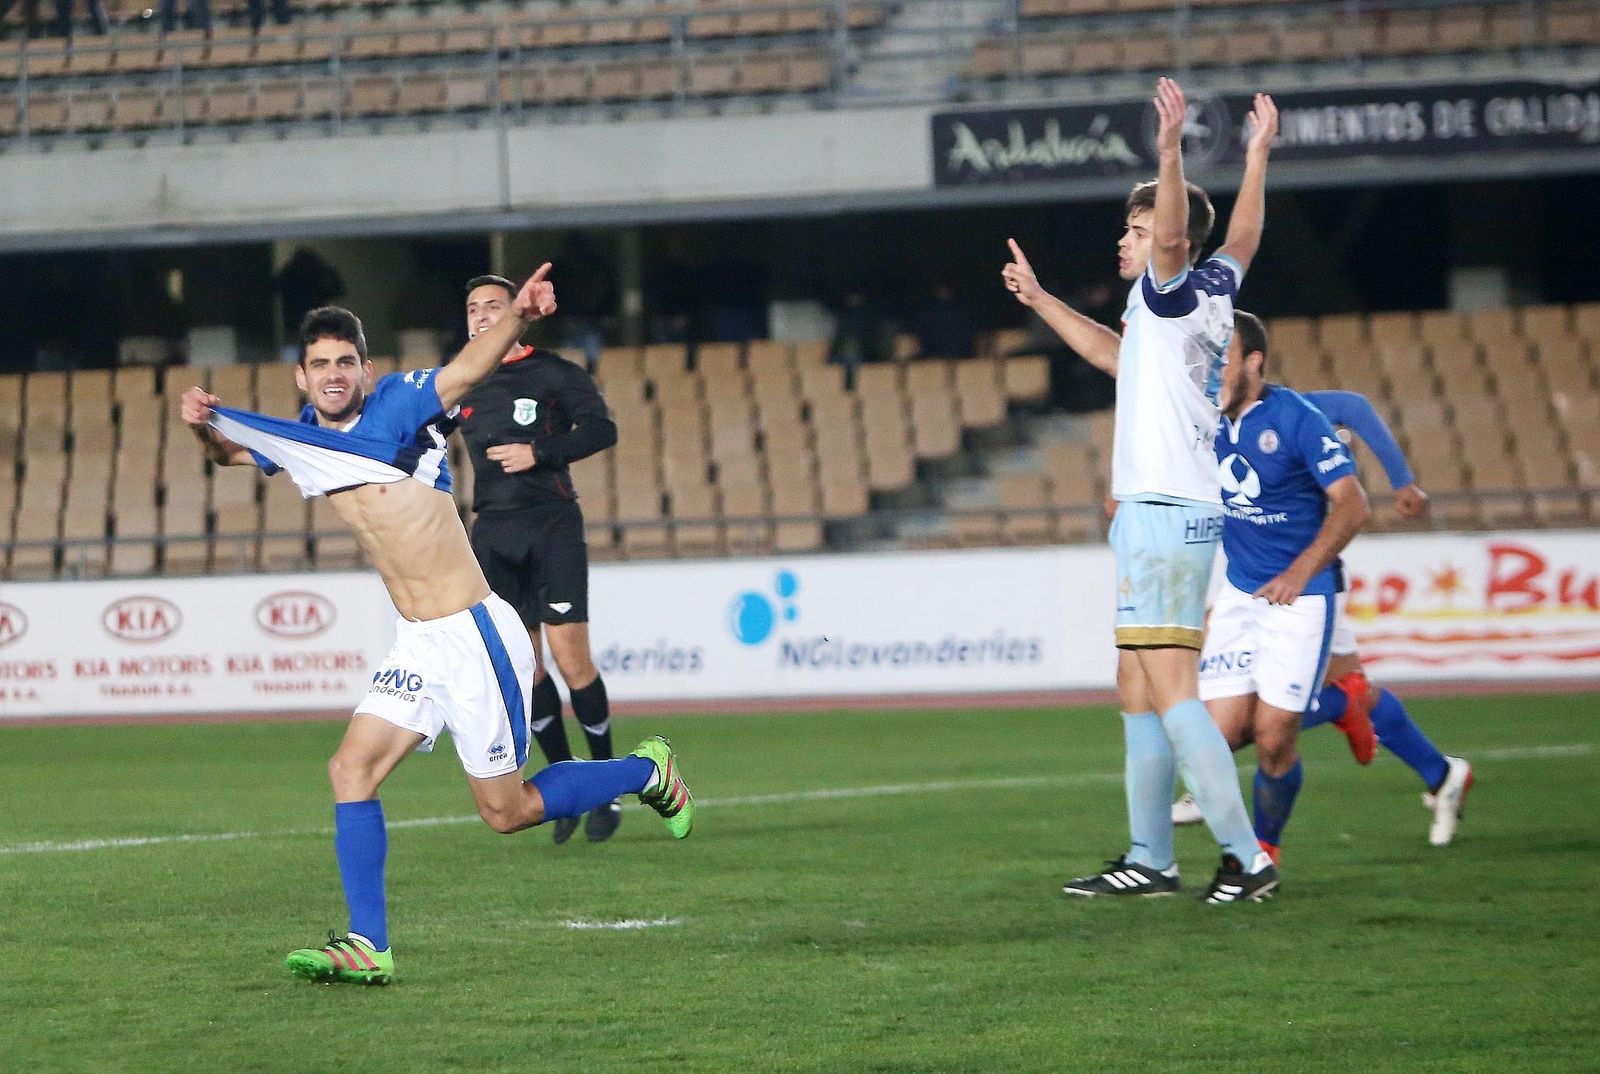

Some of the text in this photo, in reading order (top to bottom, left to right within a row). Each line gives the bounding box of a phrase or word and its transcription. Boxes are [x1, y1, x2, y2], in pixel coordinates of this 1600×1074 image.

[1240, 102, 1426, 147] IMENTOS
[1433, 98, 1476, 139] DE
[117, 605, 169, 632] KIA
[268, 603, 323, 628] KIA
[74, 655, 212, 678] KIA MOTORS
[225, 652, 368, 674] KIA MOTORS
[599, 638, 704, 673] derias
[0, 660, 58, 680] TORS
[384, 668, 423, 691] NG
[369, 684, 417, 702] nderias
